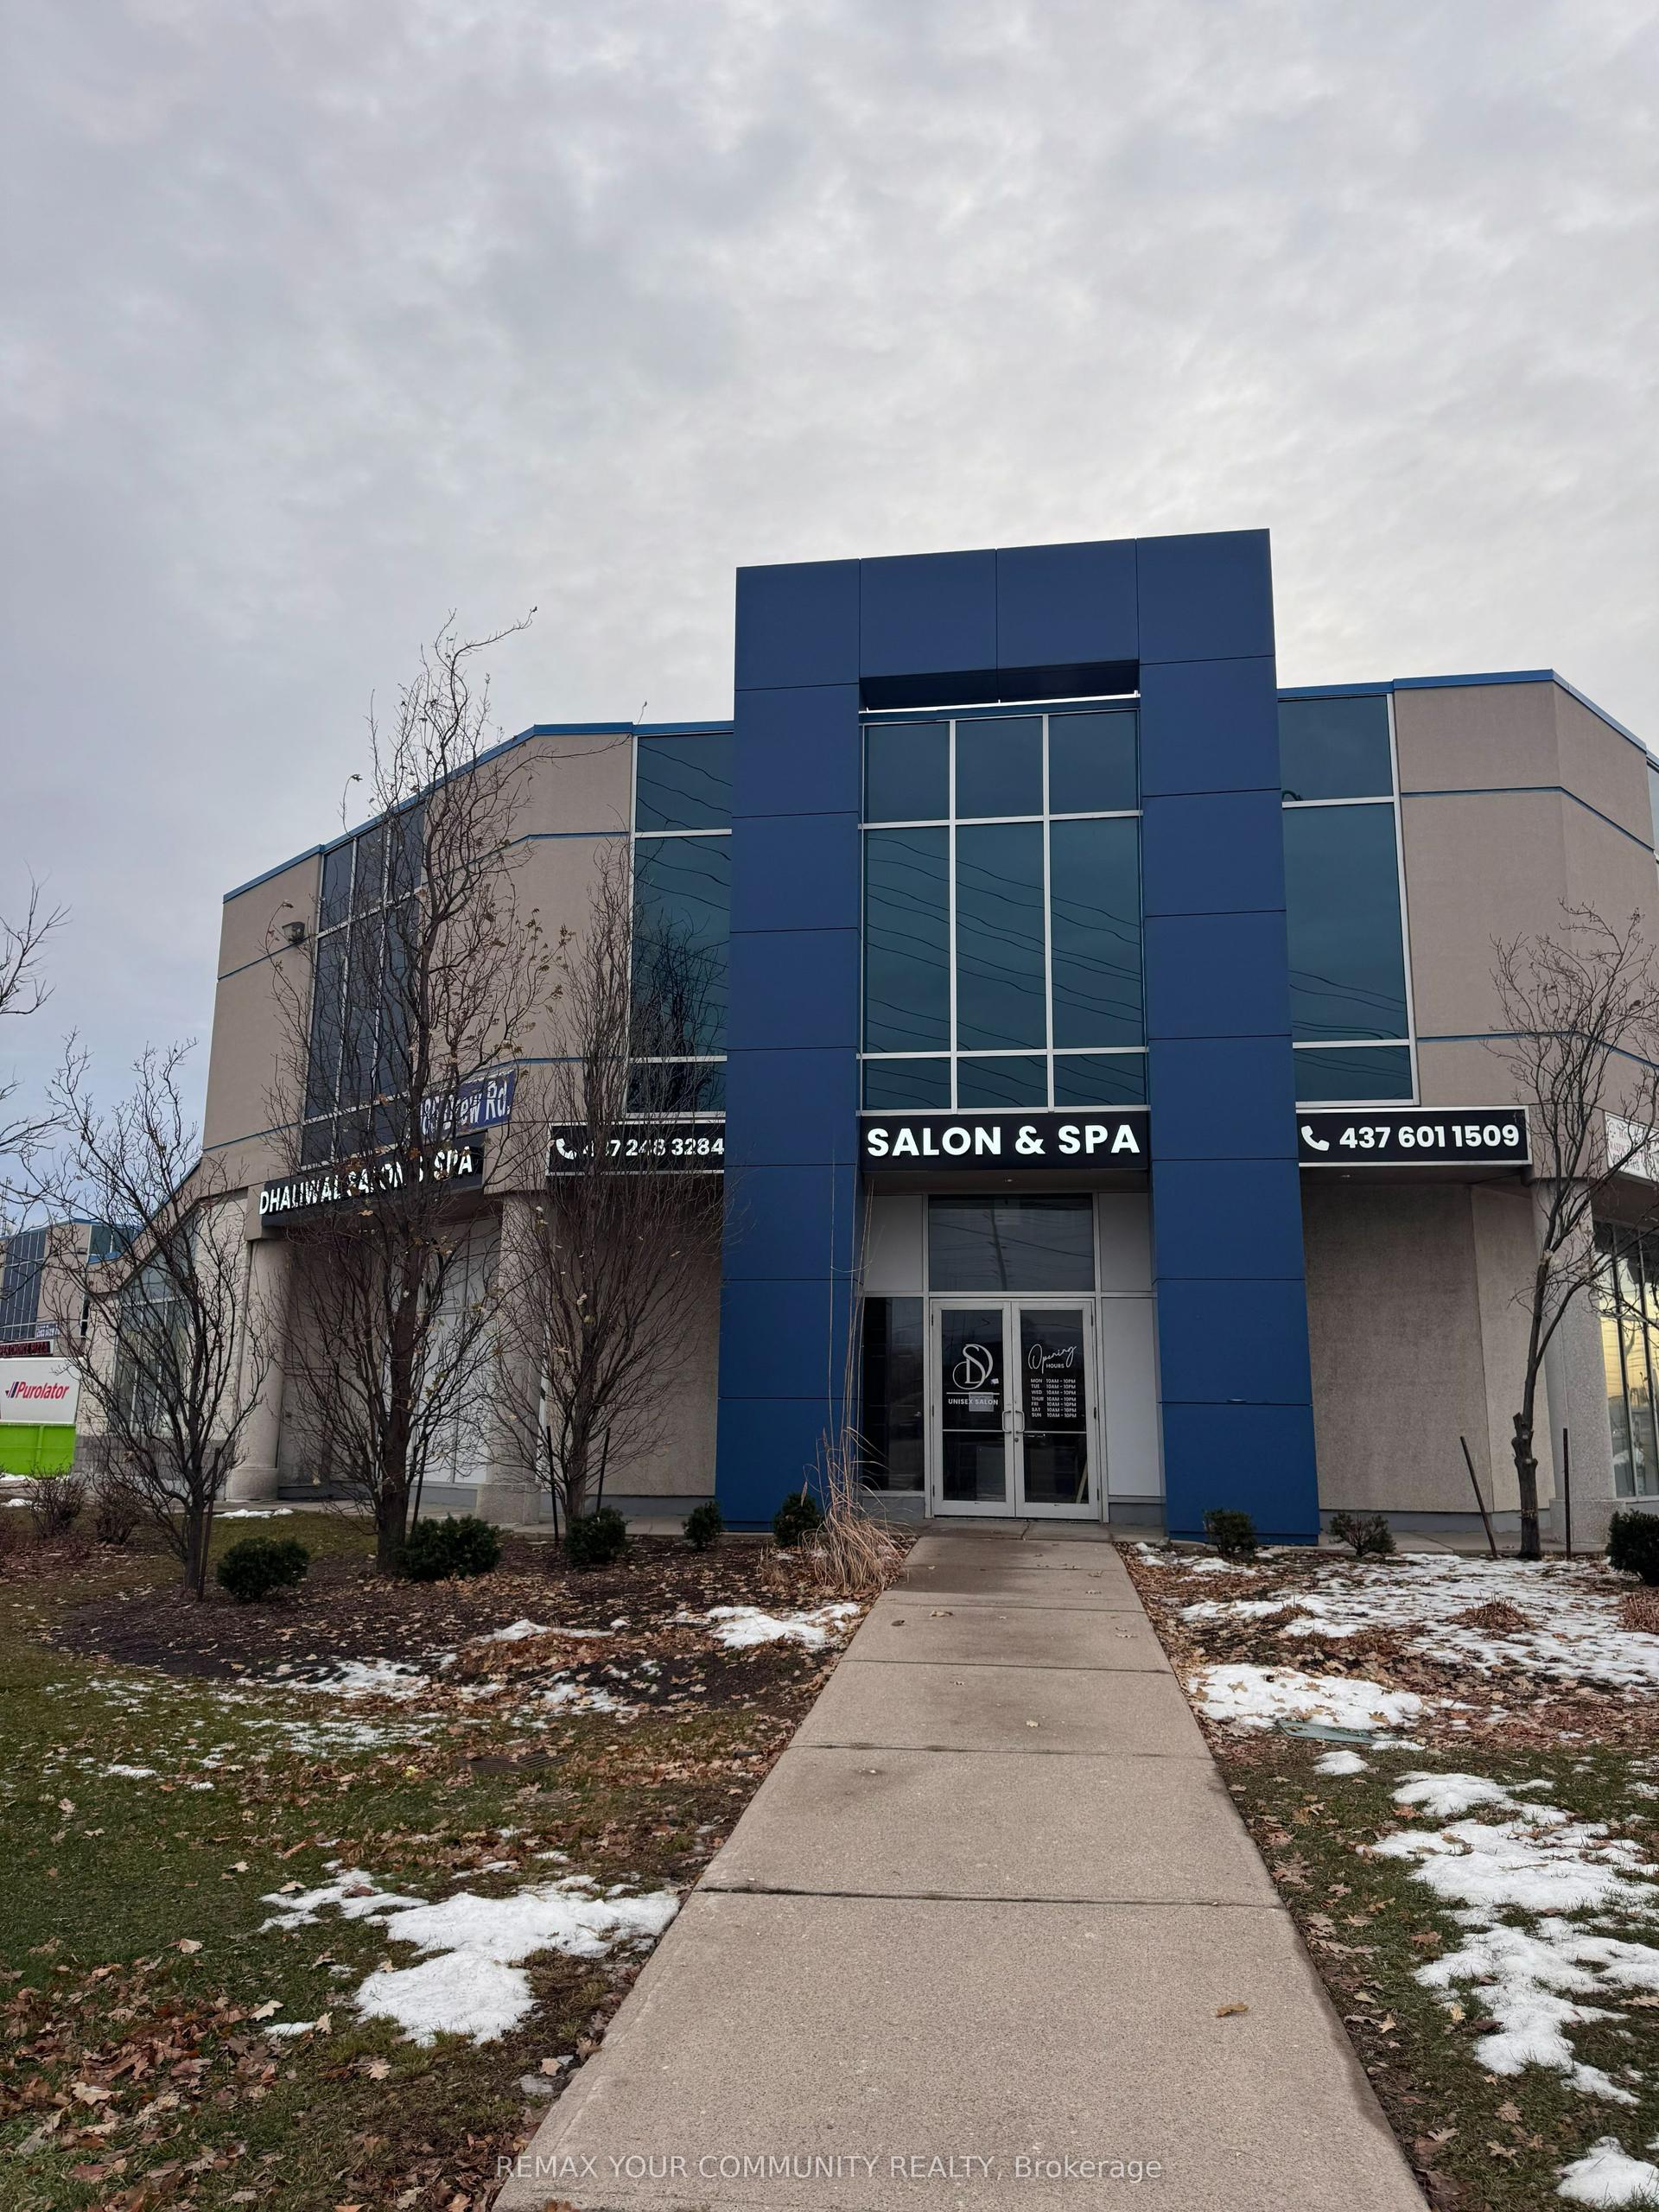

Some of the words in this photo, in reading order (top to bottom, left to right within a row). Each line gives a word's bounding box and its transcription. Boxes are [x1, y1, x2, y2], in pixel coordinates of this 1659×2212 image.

[485, 1079, 511, 1122] Rd.
[671, 1137, 725, 1156] 3284
[867, 1126, 1001, 1156] SALON
[1014, 1125, 1046, 1154] &
[1058, 1124, 1141, 1154] SPA
[1339, 1127, 1391, 1148] 437
[1398, 1125, 1446, 1147] 601
[1452, 1124, 1520, 1147] 1509
[258, 1174, 341, 1215] DHALIWAL
[1028, 1344, 1077, 1374] Opening
[15, 1381, 70, 1400] Purolator
